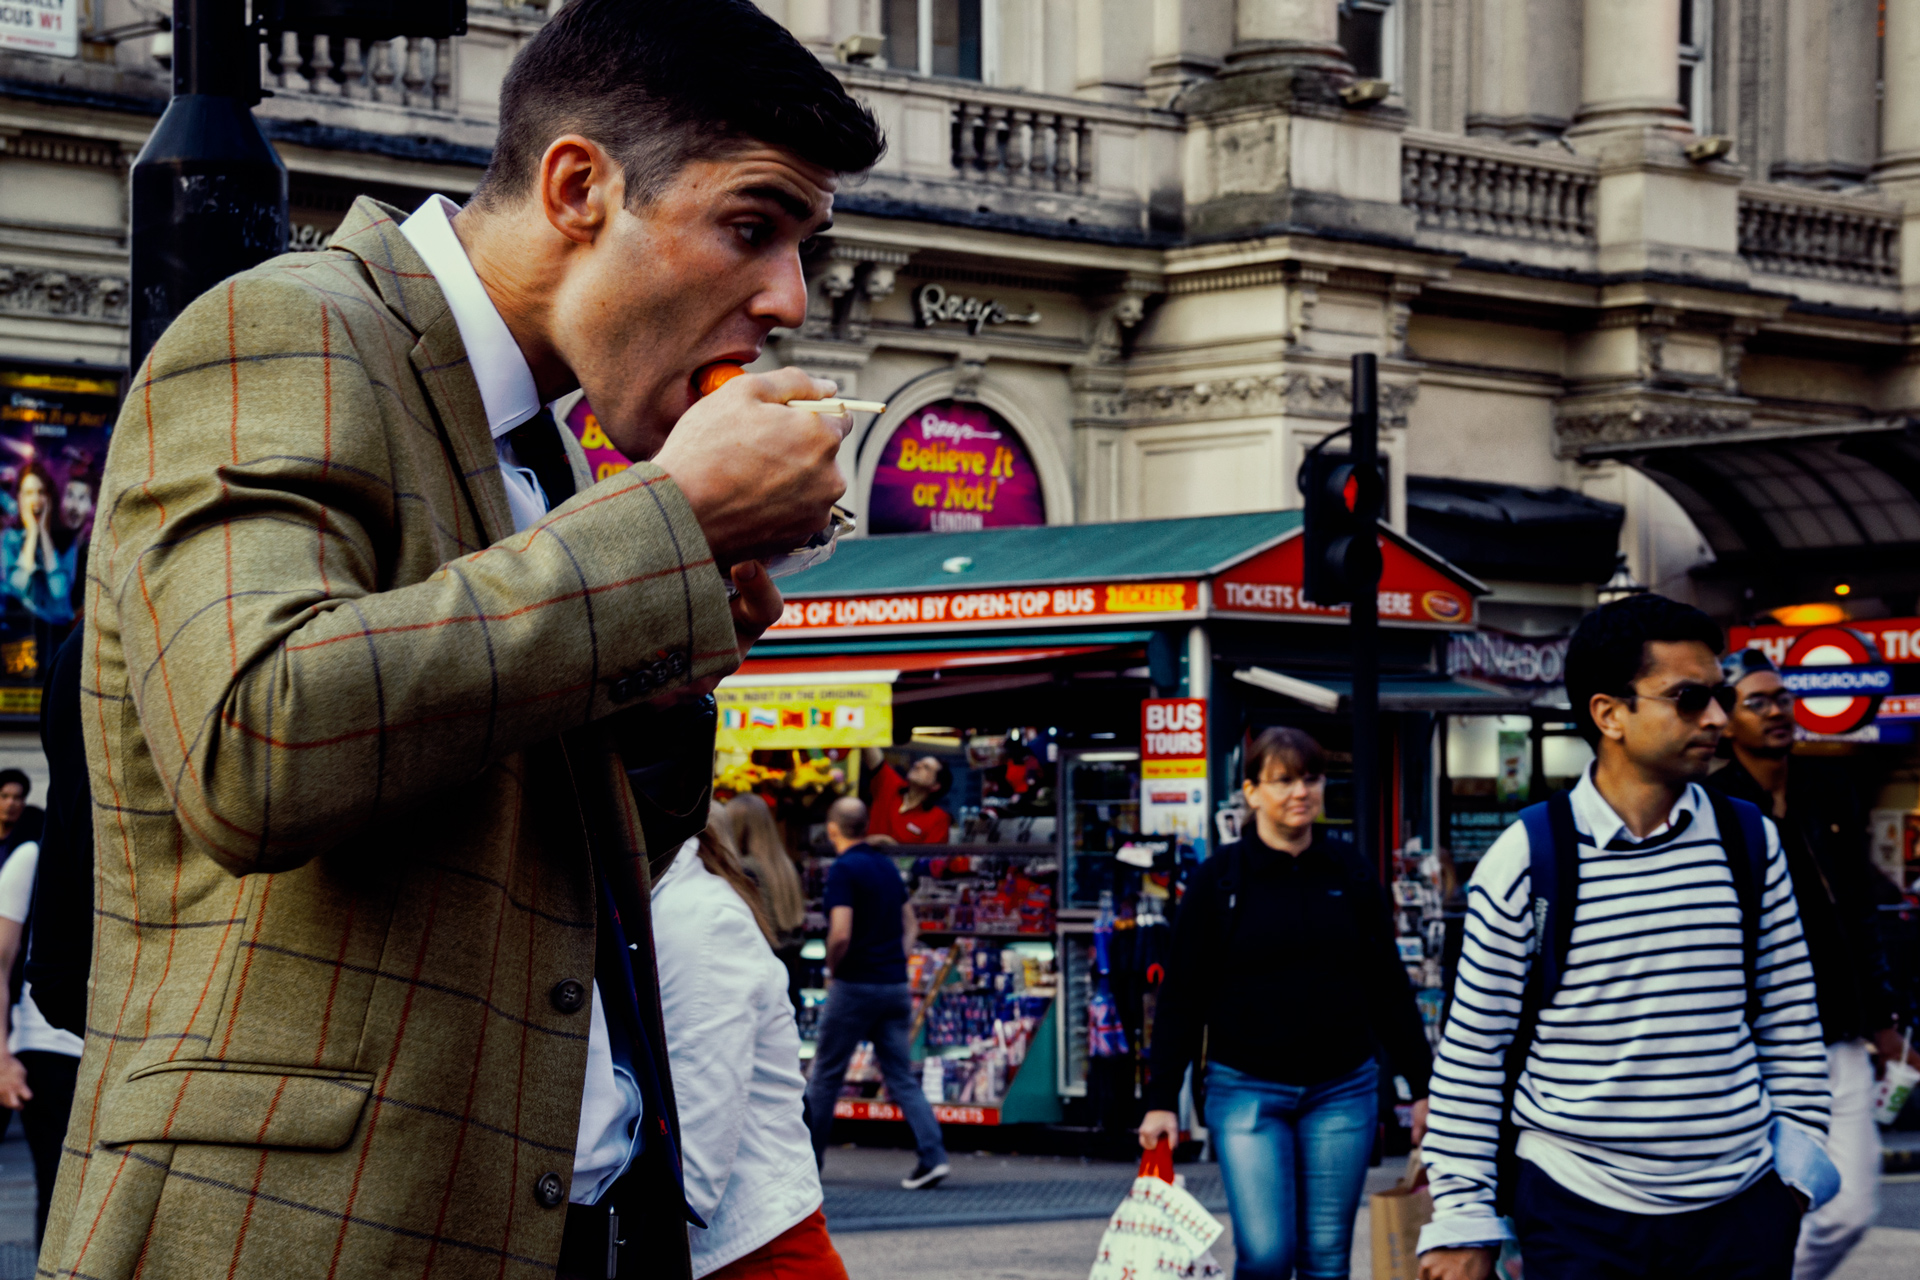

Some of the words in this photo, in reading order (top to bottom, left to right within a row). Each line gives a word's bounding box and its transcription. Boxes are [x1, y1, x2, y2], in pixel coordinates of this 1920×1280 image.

[40, 11, 62, 32] W1
[897, 438, 987, 476] Believe
[989, 445, 1014, 477] It
[912, 483, 942, 507] or
[943, 477, 998, 512] Not!
[930, 511, 984, 532] LONDON
[806, 601, 832, 625] OF
[835, 598, 919, 625] LONDON
[922, 596, 949, 620] BY
[951, 589, 1050, 619] OPEN-TOP
[1053, 588, 1095, 614] BUS
[1113, 584, 1178, 608] TICKETS
[1223, 582, 1295, 609] TICKETS
[1145, 703, 1203, 731] BUS
[1144, 731, 1204, 755] TOURS
[867, 1102, 895, 1120] BUS
